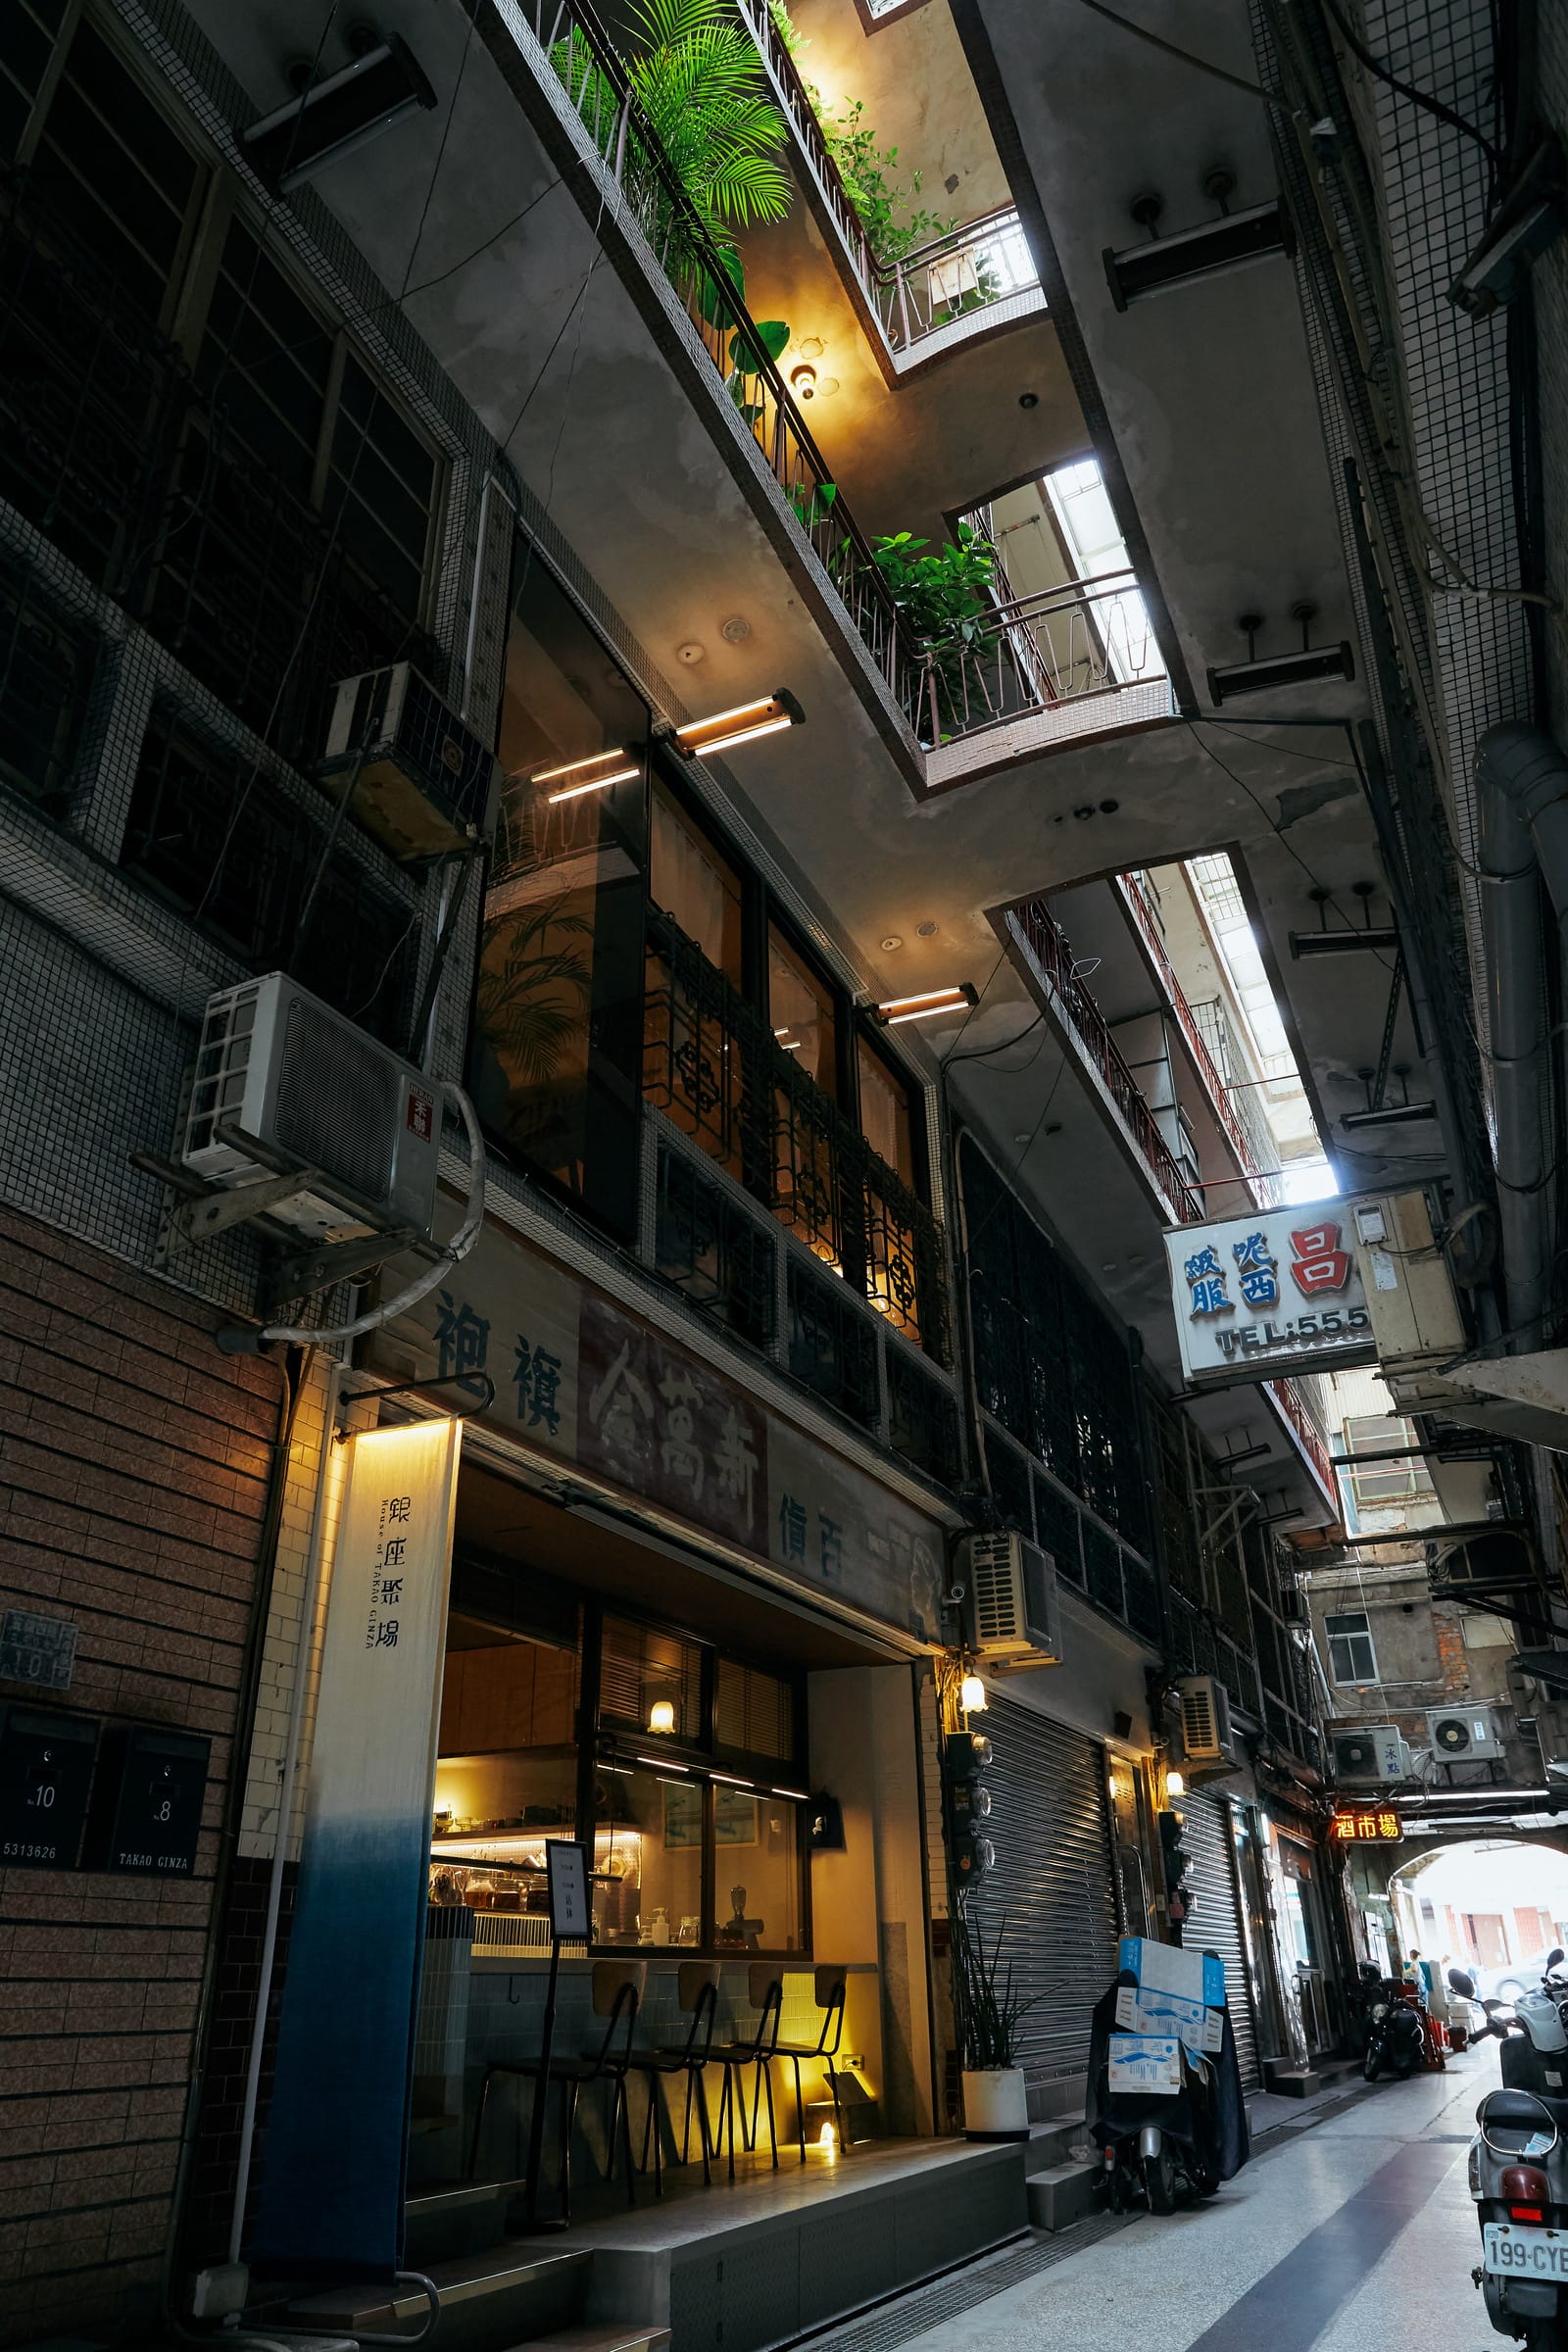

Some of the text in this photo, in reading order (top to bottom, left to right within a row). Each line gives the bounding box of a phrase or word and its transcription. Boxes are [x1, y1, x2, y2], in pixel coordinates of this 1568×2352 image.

[376, 1498, 389, 1538] House
[370, 1563, 382, 1603] TAKAO
[375, 1496, 412, 1648] 銀座聚場
[366, 1610, 377, 1649] GINZA
[1335, 1814, 1399, 1838] 酒市場
[3, 1842, 57, 1859] 5313626
[119, 1852, 188, 1870] TAKAO GINZA
